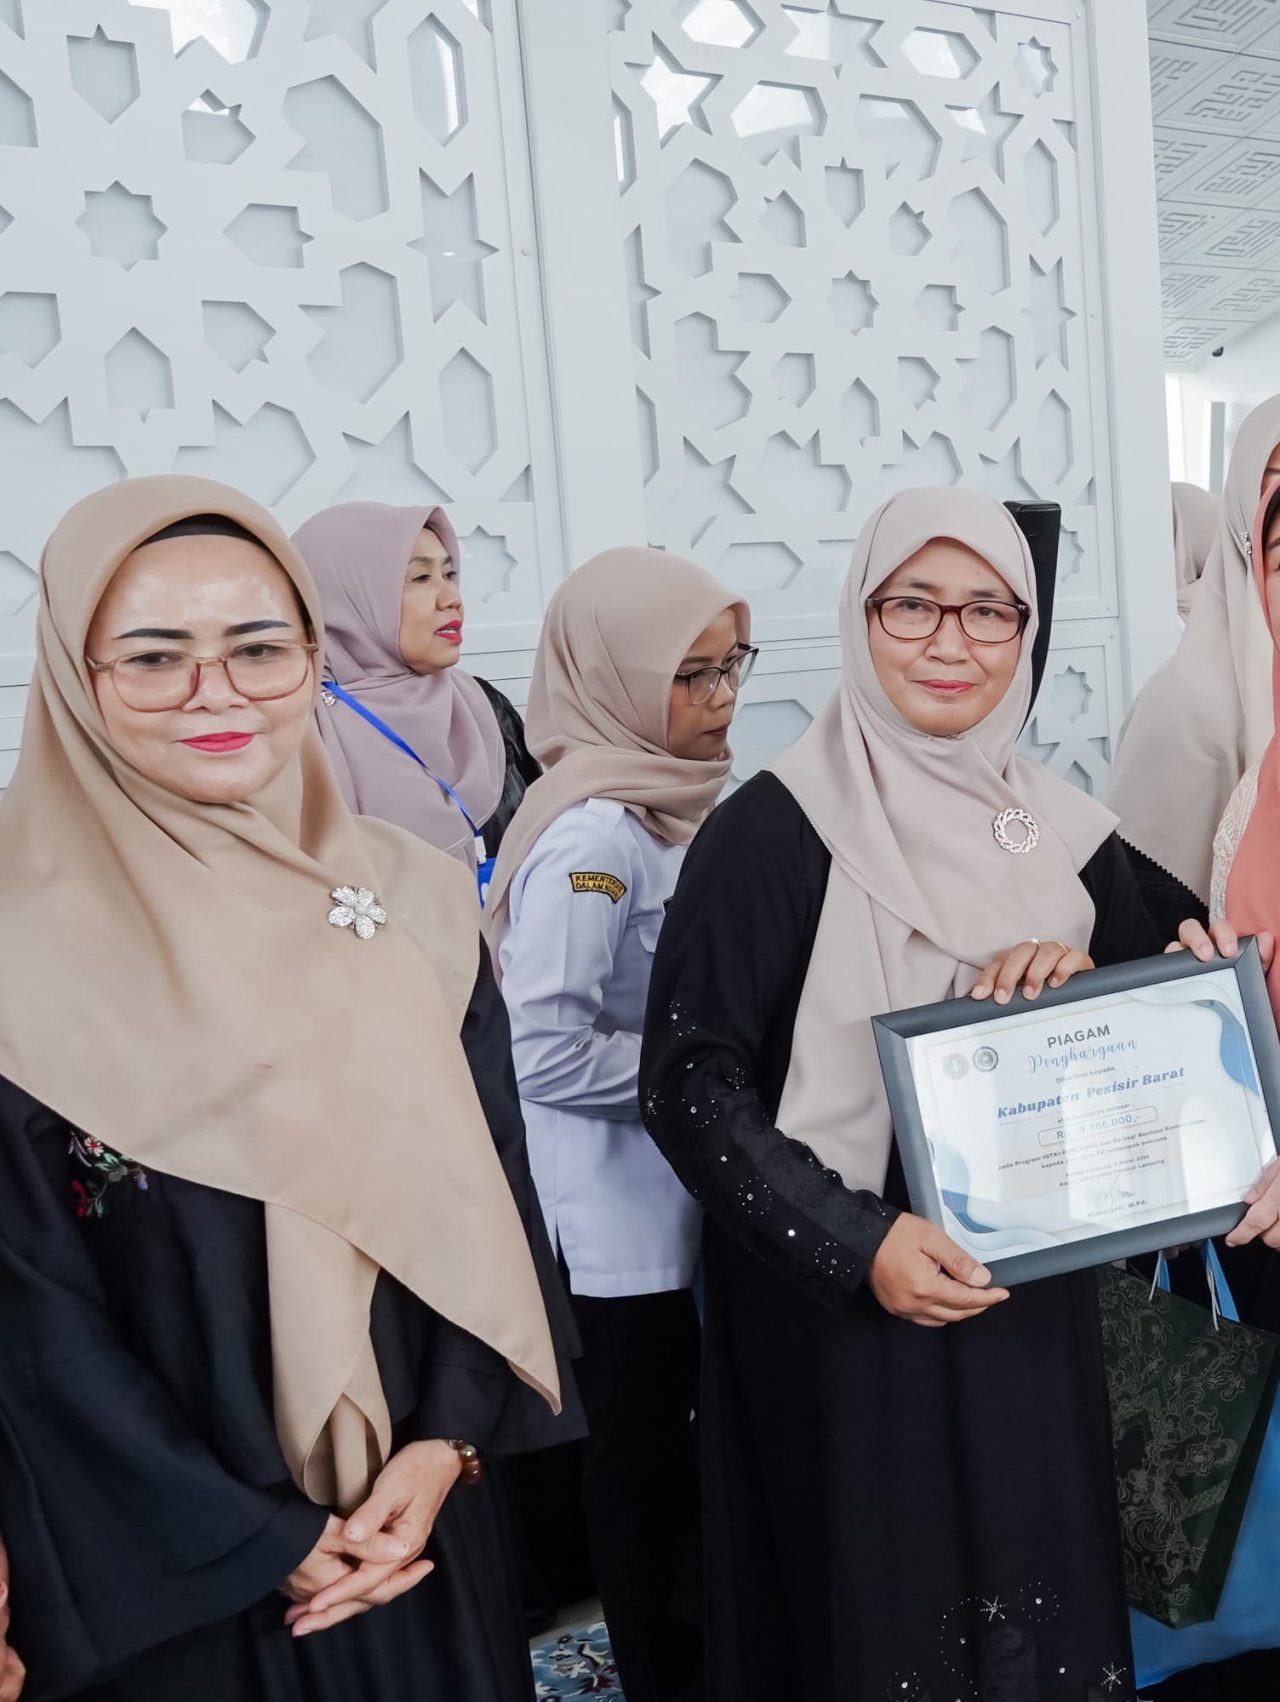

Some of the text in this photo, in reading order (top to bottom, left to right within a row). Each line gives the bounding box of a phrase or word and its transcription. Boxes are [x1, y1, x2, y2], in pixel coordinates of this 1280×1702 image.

[1046, 1024, 1111, 1049] PIAGAM
[1027, 1038, 1138, 1074] Penghargaan
[1086, 1078, 1139, 1099] Pesisir
[1142, 1067, 1185, 1086] Barat
